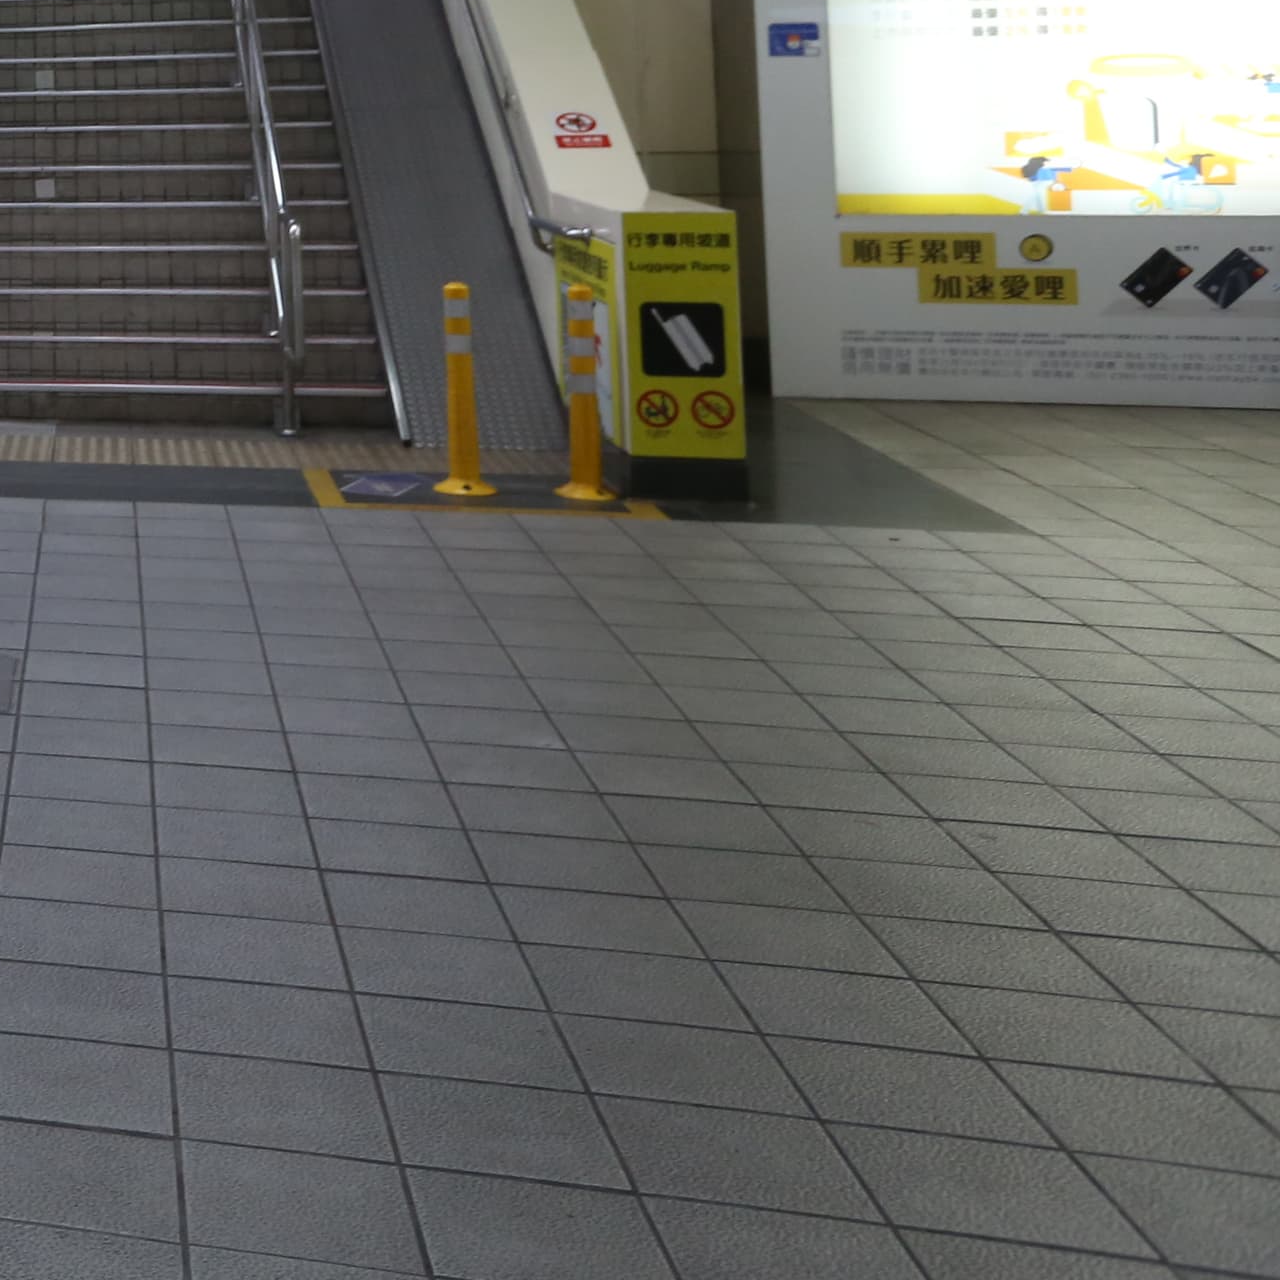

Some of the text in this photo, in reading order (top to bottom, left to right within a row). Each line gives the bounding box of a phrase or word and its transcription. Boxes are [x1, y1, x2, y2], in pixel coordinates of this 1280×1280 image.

[853, 238, 984, 265] 順手累哩
[629, 260, 731, 274] Luggage Ramp
[933, 273, 1065, 301] 加速愛哩
